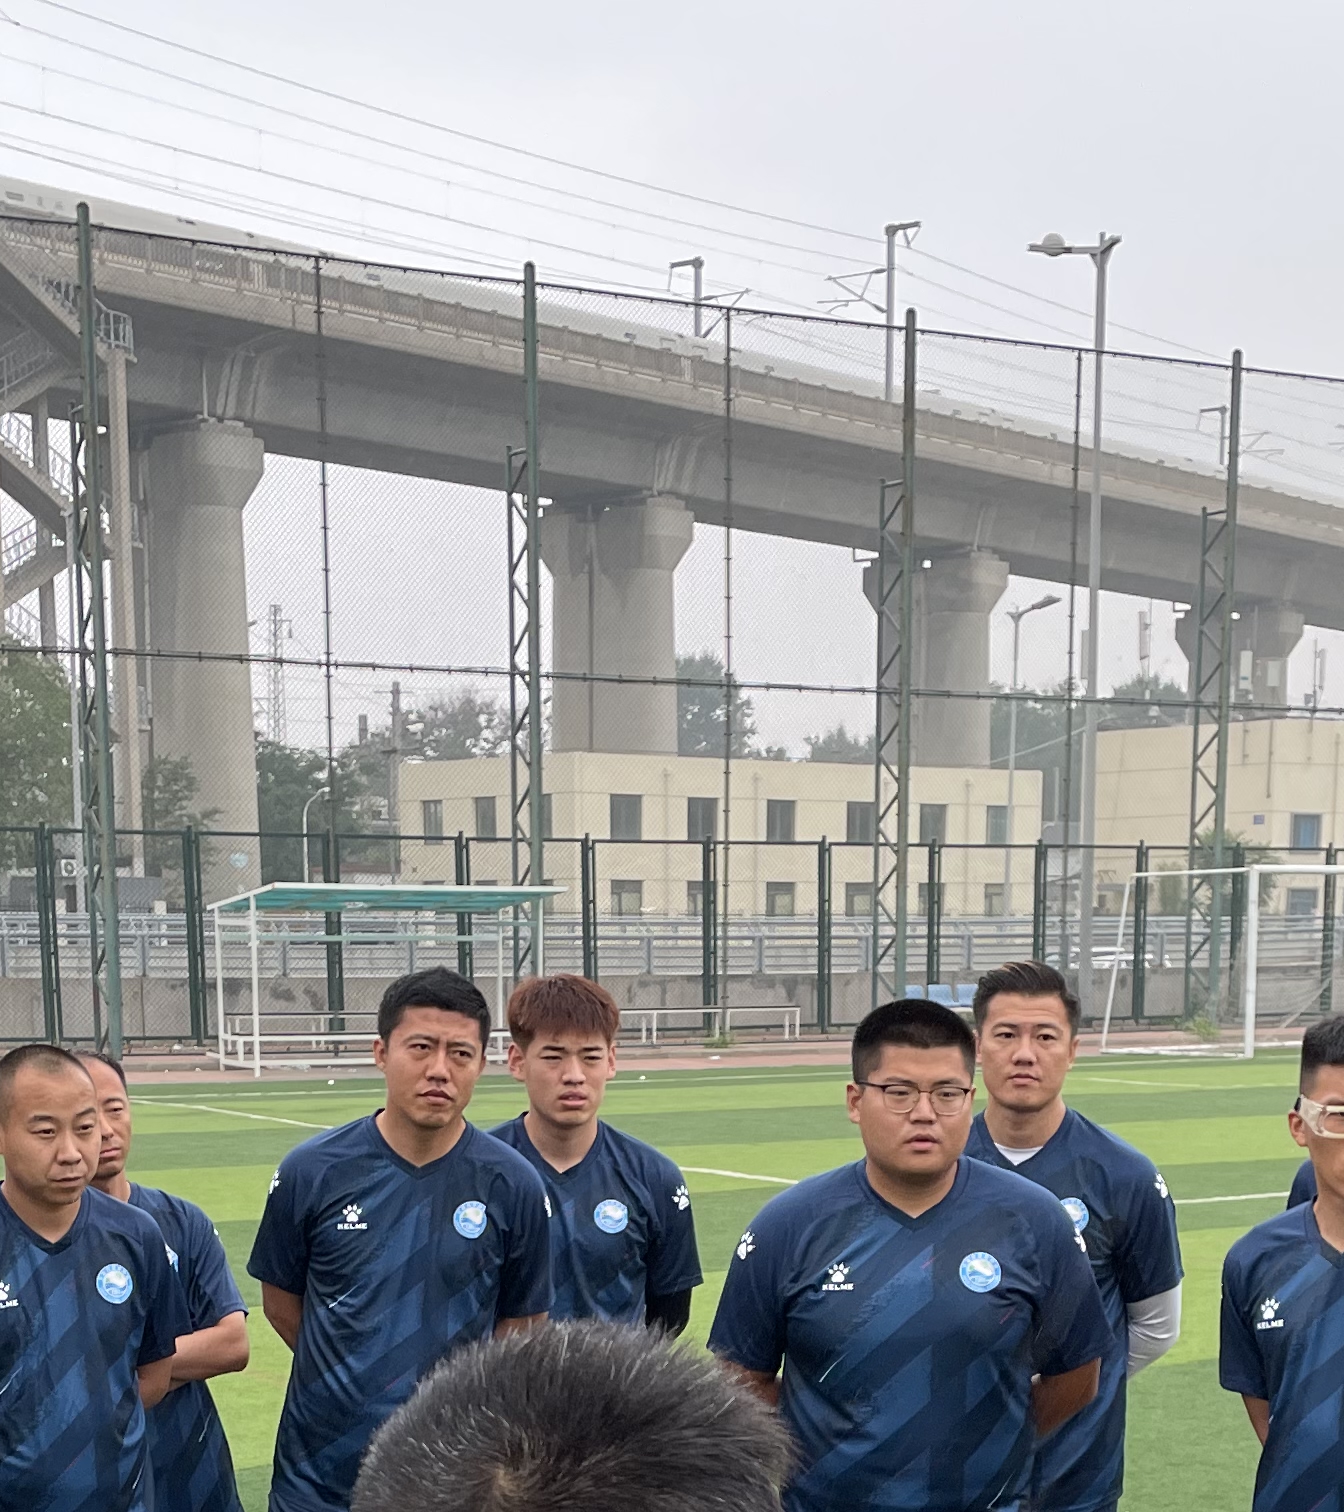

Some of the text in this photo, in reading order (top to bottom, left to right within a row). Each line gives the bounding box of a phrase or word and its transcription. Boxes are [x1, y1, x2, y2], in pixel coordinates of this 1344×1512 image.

[336, 1222, 368, 1231] KELME
[821, 1282, 855, 1291] KELME
[1256, 1318, 1284, 1330] KELME
